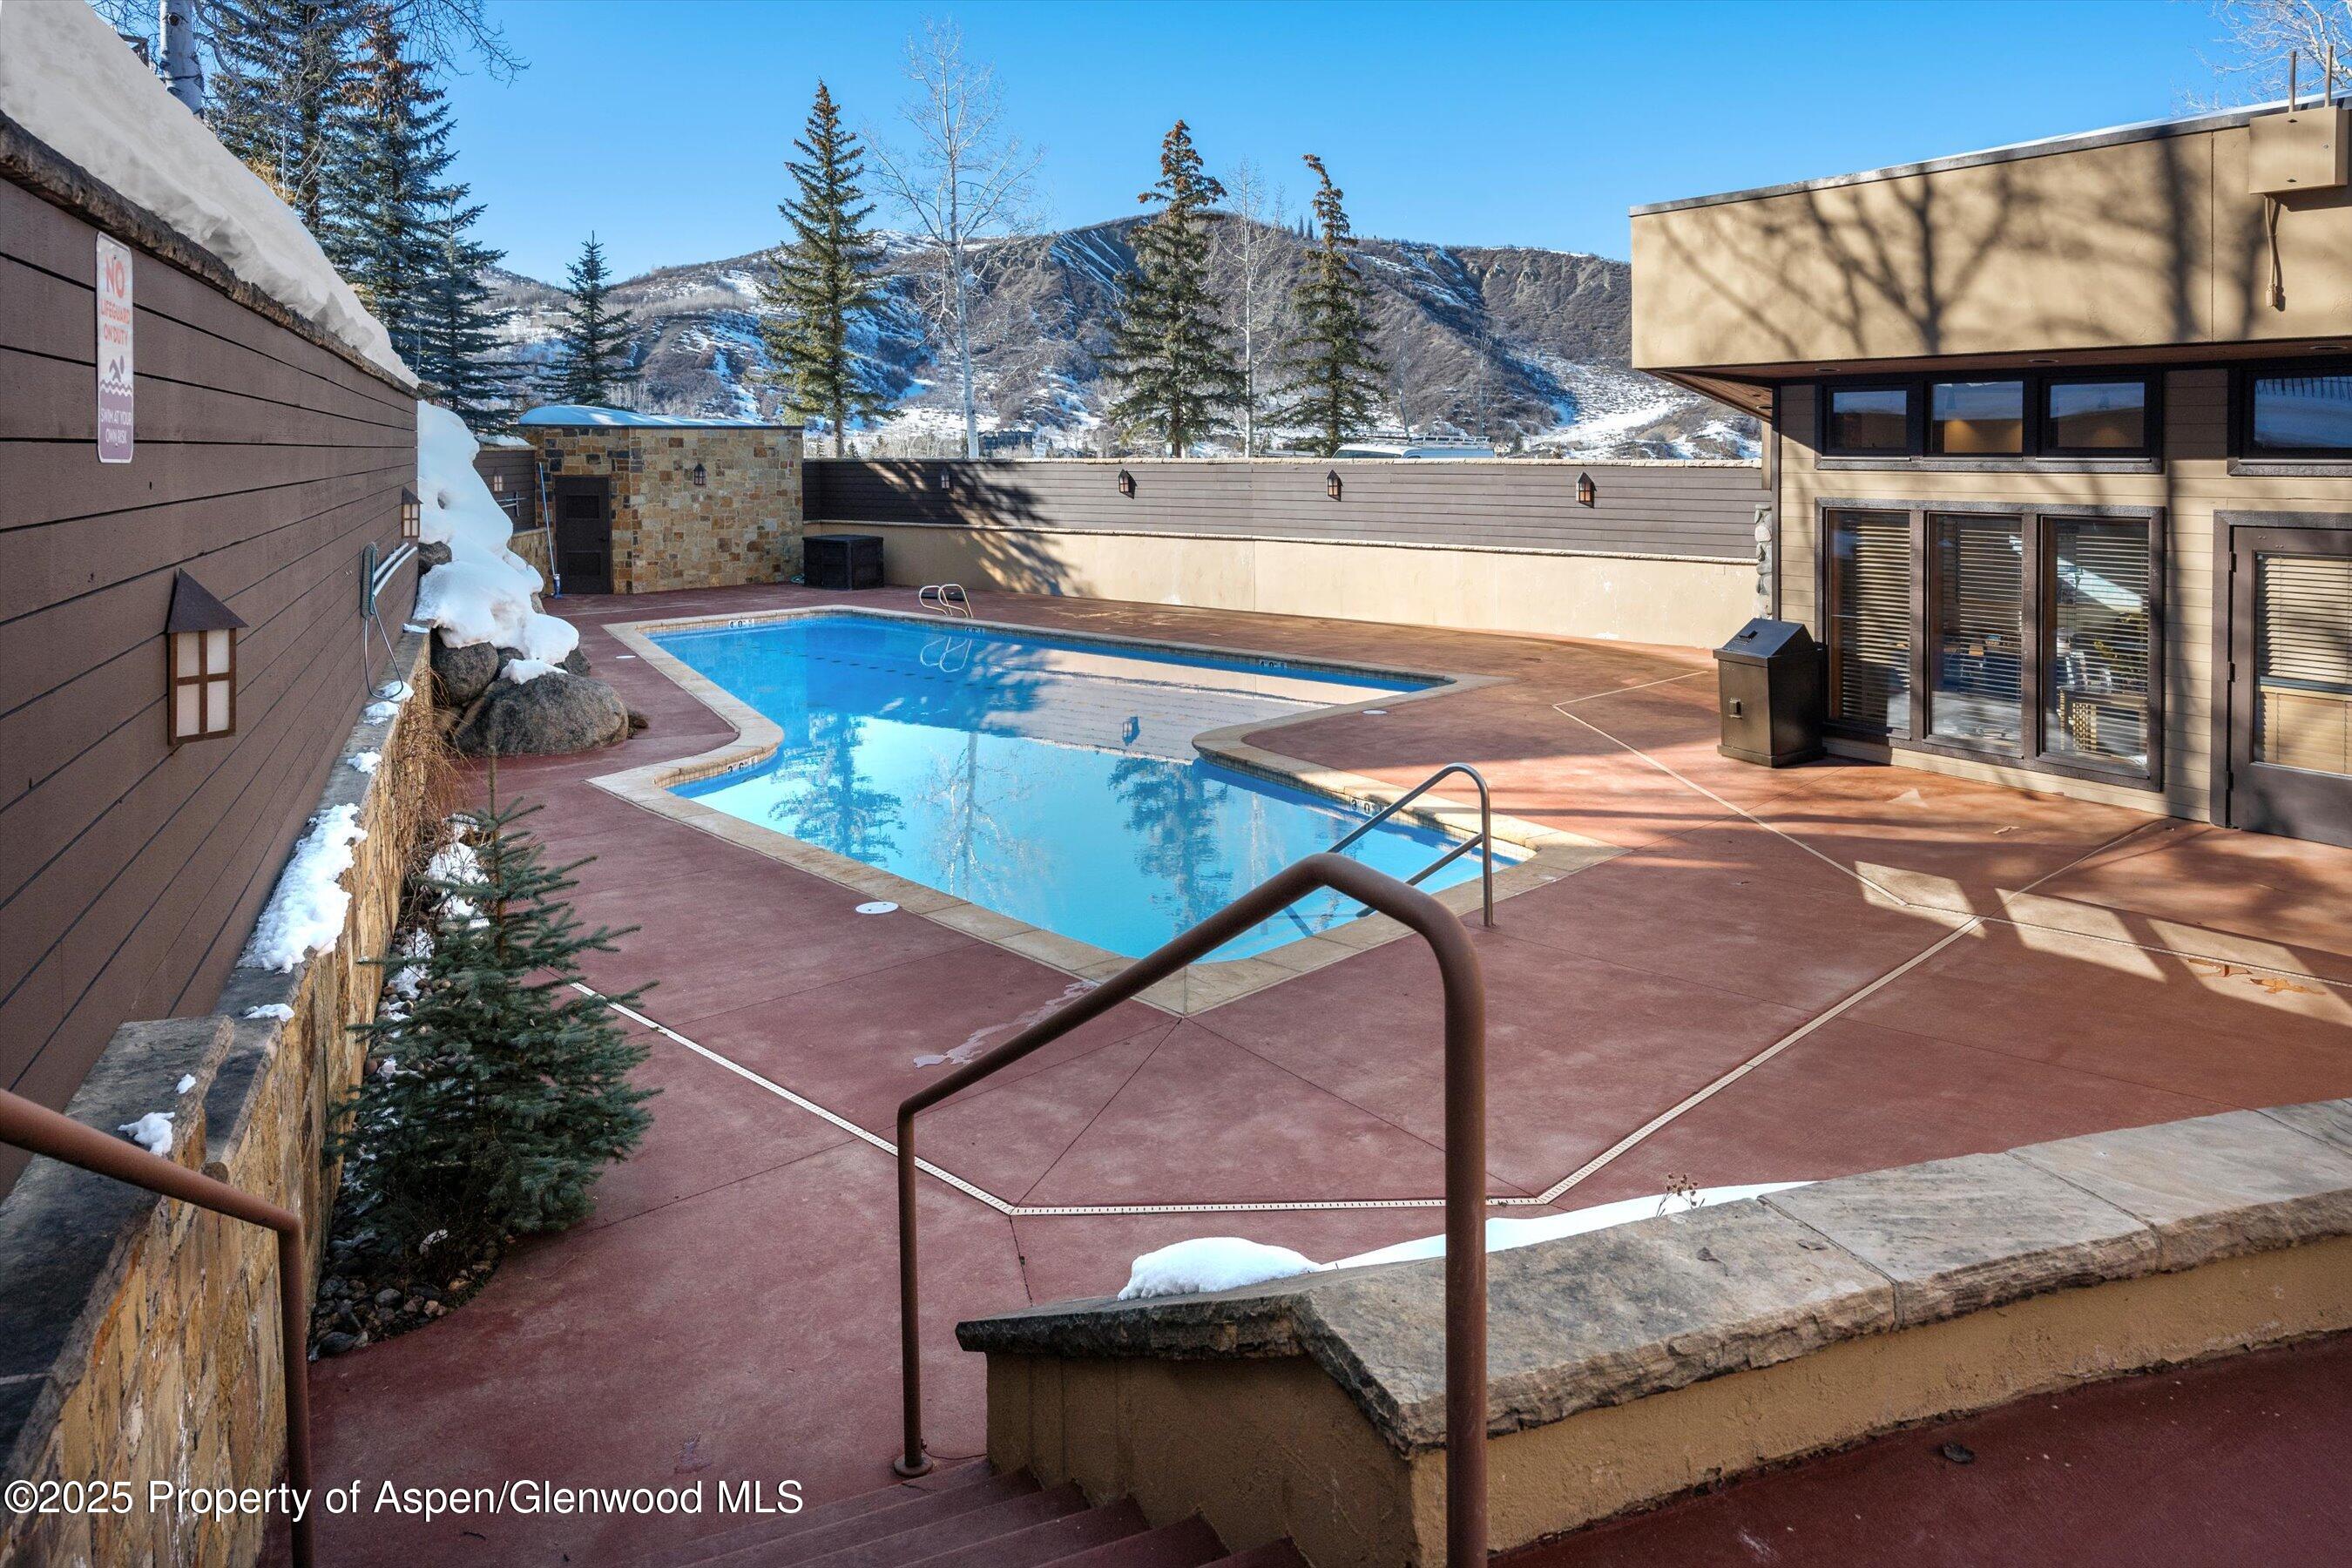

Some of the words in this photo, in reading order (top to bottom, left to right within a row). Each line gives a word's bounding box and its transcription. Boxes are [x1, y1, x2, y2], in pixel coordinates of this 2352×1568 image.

[105, 253, 125, 299] NO
[100, 299, 130, 325] LIFEGUARD
[104, 323, 112, 341] ON
[112, 326, 128, 348] DUTY
[100, 408, 113, 423] SWIM
[120, 410, 132, 426] YOUR
[105, 428, 117, 443] OWN
[117, 429, 127, 443] RISK
